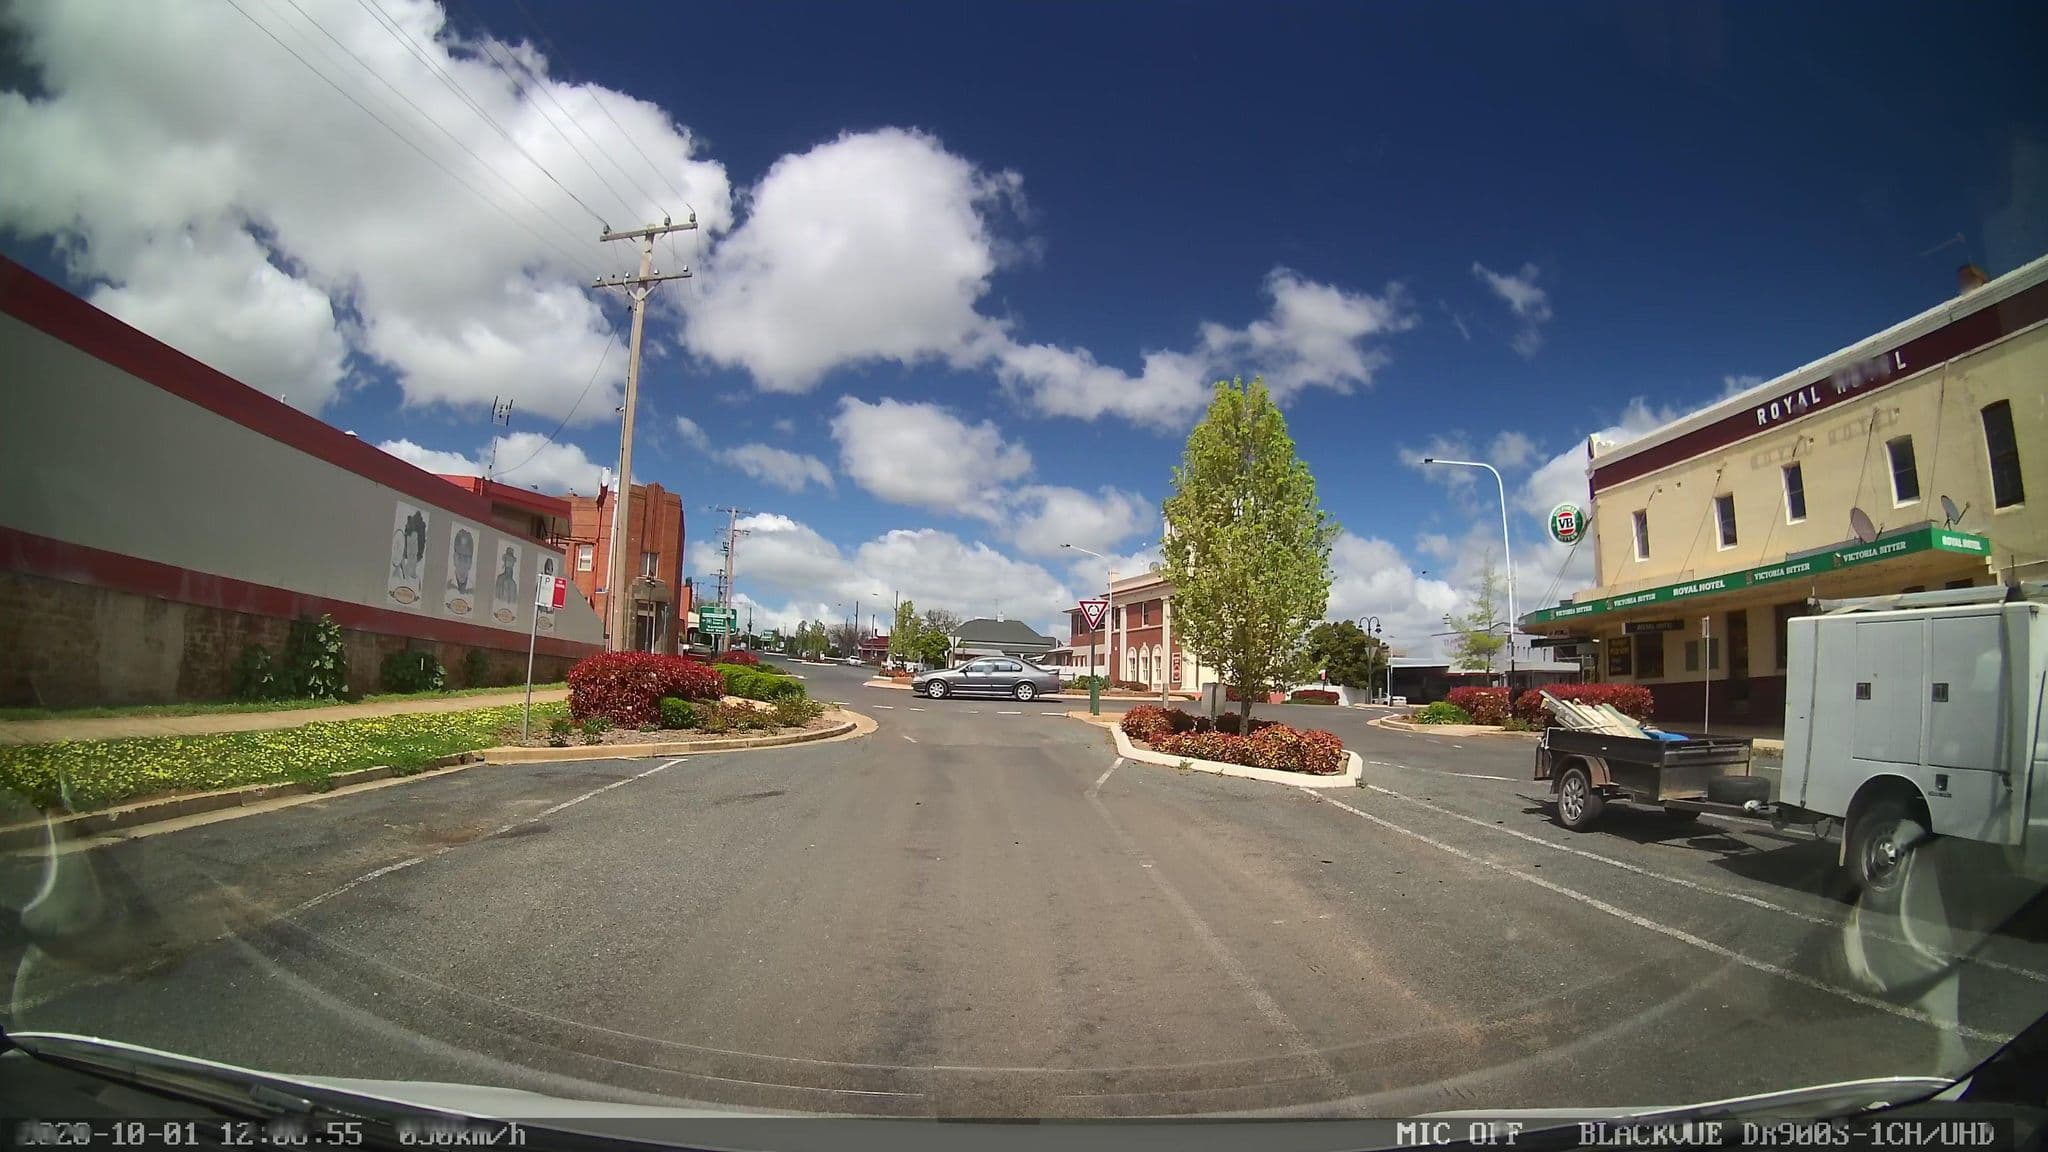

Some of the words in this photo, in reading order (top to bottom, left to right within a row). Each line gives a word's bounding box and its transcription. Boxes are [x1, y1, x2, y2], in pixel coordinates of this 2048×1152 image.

[1756, 386, 1821, 426] ROYAL
[1558, 517, 1573, 528] VB
[1843, 548, 1878, 562] VICTORIA
[1879, 541, 1906, 555] BITTER
[1754, 568, 1785, 580] VICTORIA
[1786, 562, 1810, 575] BITTER
[1673, 584, 1698, 597] ROYAL
[1699, 580, 1725, 592] HOTEL
[1614, 597, 1637, 607] VICTORIA
